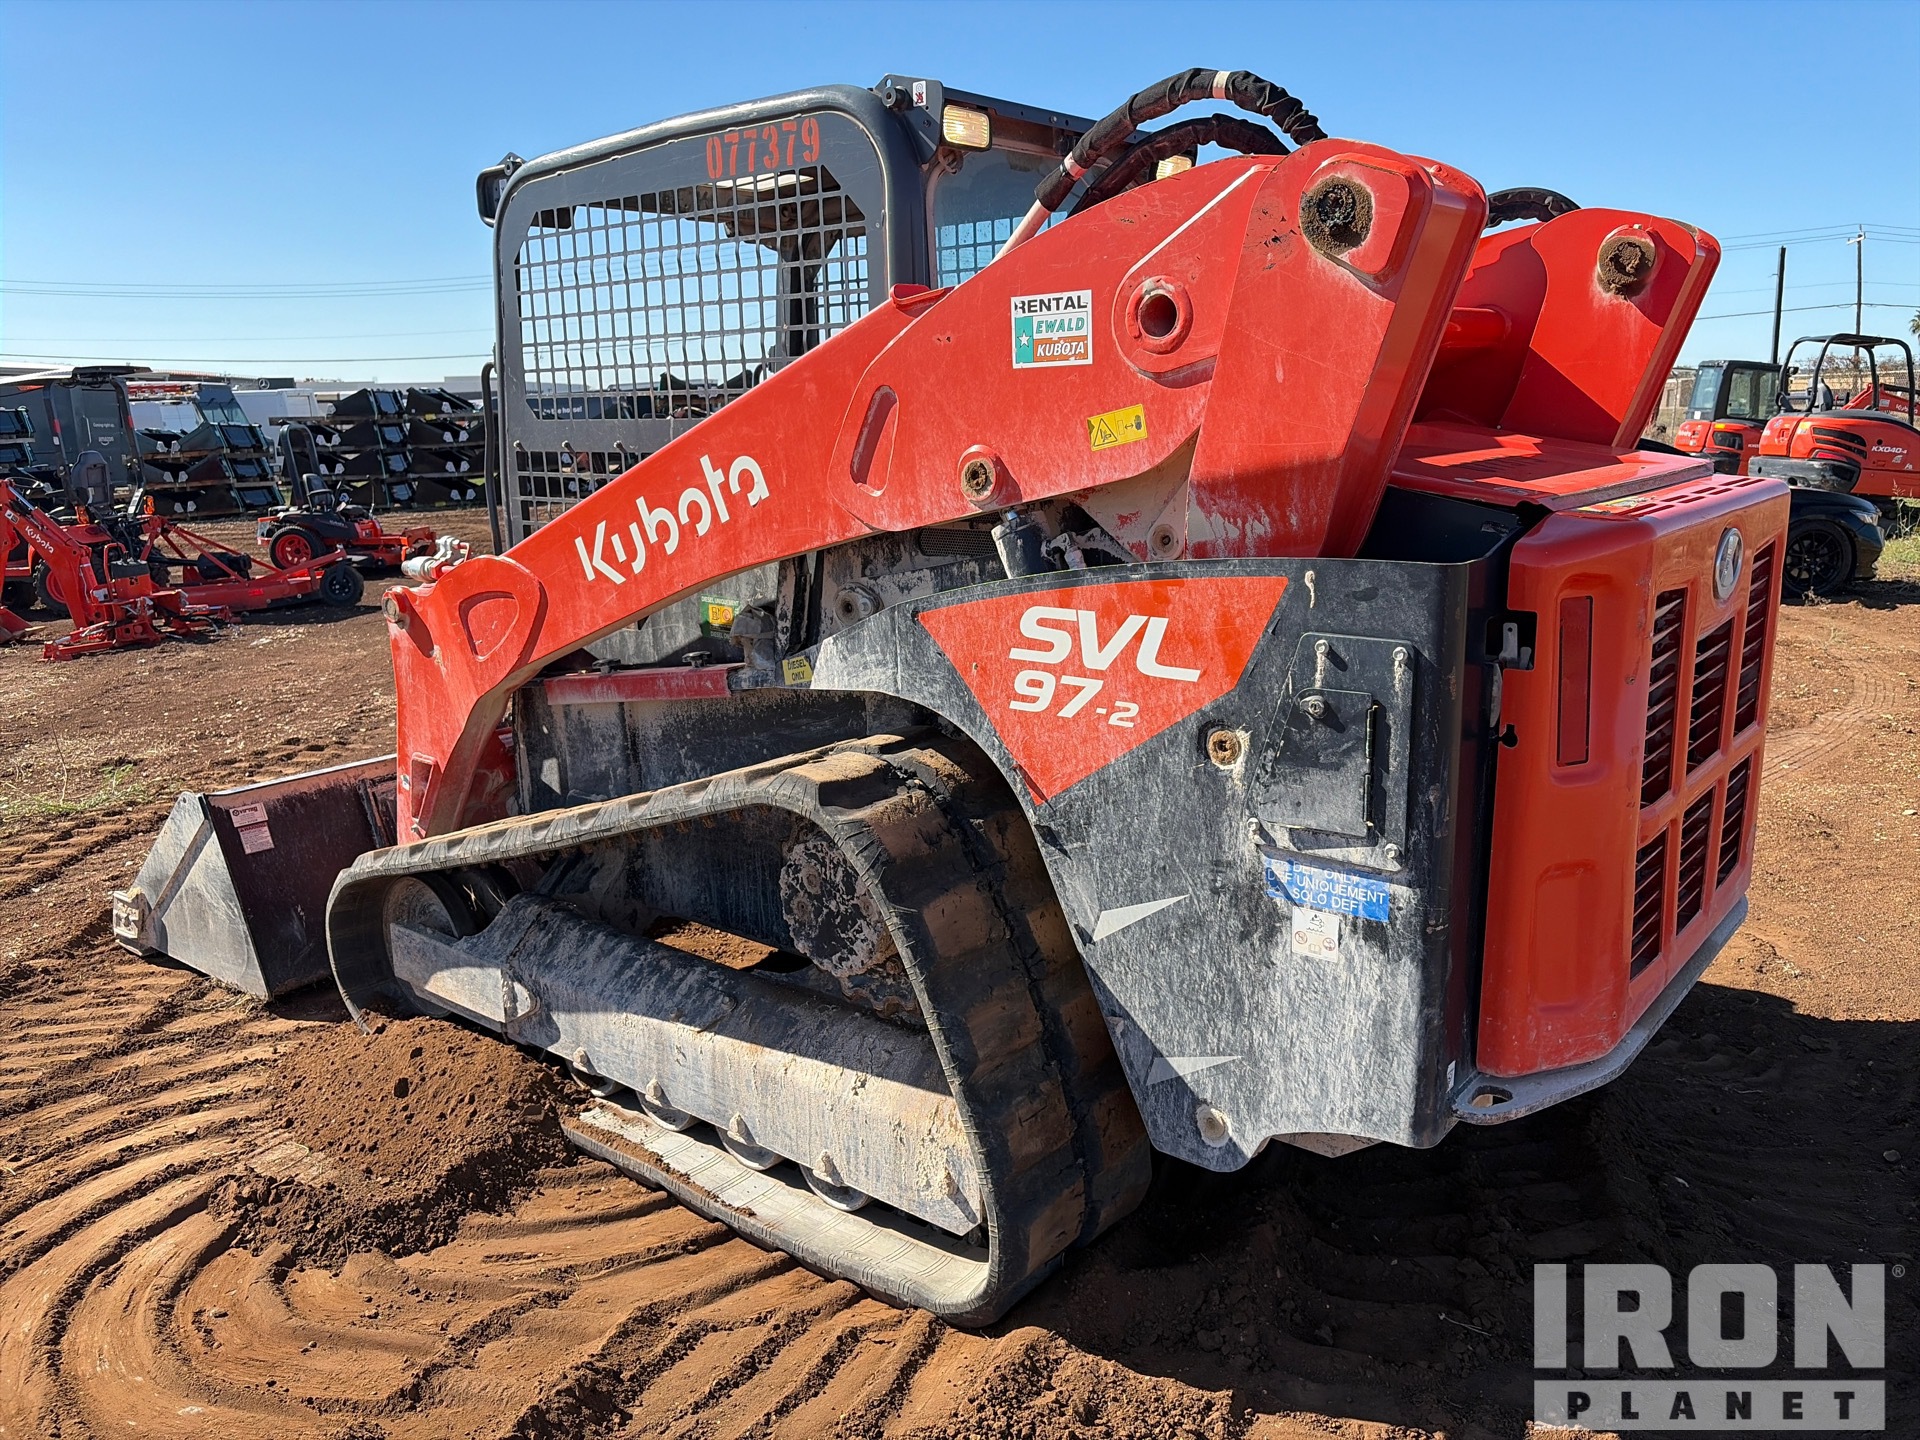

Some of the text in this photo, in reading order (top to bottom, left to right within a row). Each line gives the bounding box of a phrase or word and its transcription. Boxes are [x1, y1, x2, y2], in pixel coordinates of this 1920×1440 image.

[706, 117, 820, 179] 077379
[1014, 295, 1088, 314] RENTAL
[1035, 317, 1085, 334] EWALD
[1036, 341, 1085, 357] KUBOTA
[574, 454, 770, 584] Kubota
[25, 526, 54, 554] Kubota
[1008, 606, 1201, 682] SVL
[787, 658, 806, 670] DIESEL
[792, 670, 805, 681] ONLY
[1009, 669, 1140, 728] 97-2
[1293, 861, 1360, 885] DEF ONLY
[1267, 869, 1386, 904] DEF UNIQUEMENT
[1292, 888, 1359, 912] SOLO DEF
